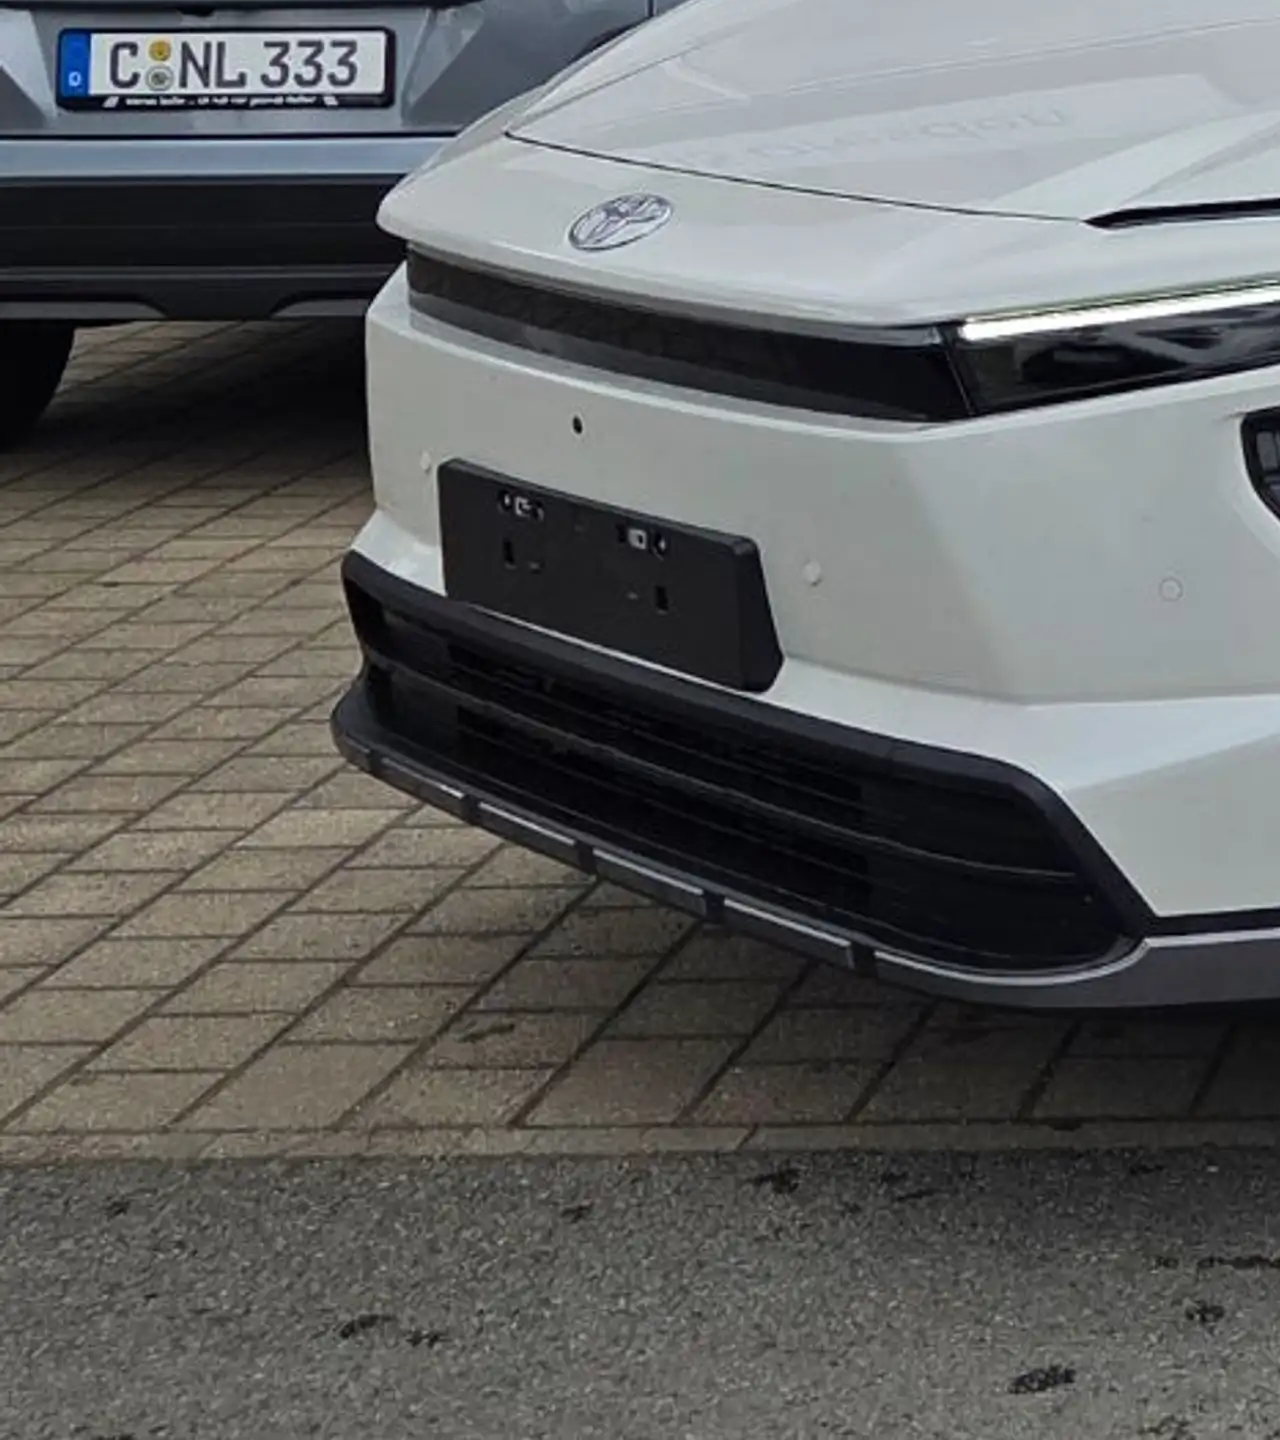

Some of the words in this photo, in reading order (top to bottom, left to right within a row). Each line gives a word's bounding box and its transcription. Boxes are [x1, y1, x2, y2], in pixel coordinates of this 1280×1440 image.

[109, 41, 141, 89] C
[178, 40, 247, 88] NL
[259, 40, 358, 88] 333
